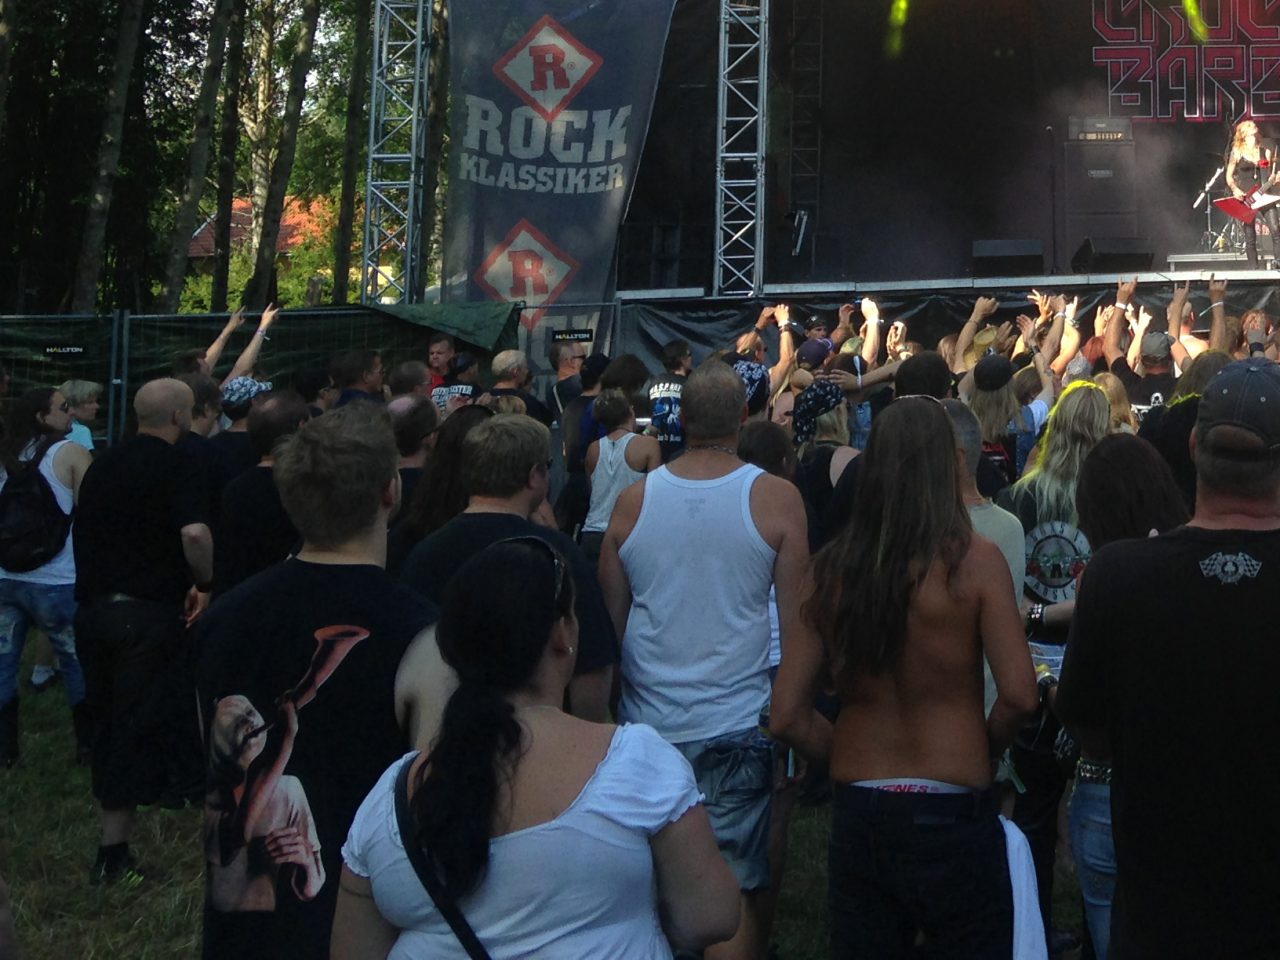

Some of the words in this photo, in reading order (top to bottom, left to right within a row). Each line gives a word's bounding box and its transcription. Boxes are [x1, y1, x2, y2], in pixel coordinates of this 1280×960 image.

[529, 44, 570, 91] R
[462, 94, 633, 163] ROCK
[458, 152, 626, 194] KLASSIKER
[507, 248, 549, 297] R
